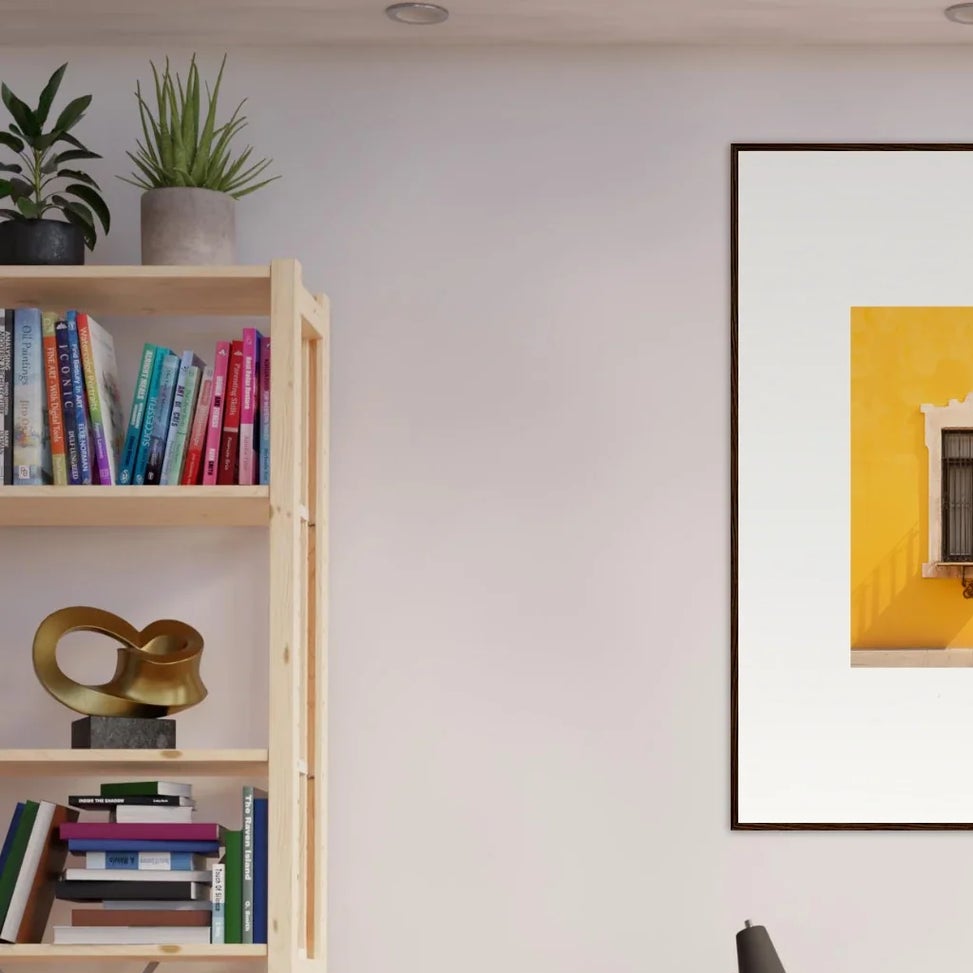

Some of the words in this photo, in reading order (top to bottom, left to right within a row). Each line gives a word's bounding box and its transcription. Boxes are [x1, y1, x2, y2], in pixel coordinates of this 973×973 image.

[22, 325, 33, 340] Oil
[17, 342, 31, 385] Paintings
[58, 344, 73, 408] ICONIC
[79, 327, 93, 373] Watercolor
[86, 375, 99, 411] Portraits
[229, 397, 238, 416] Skills
